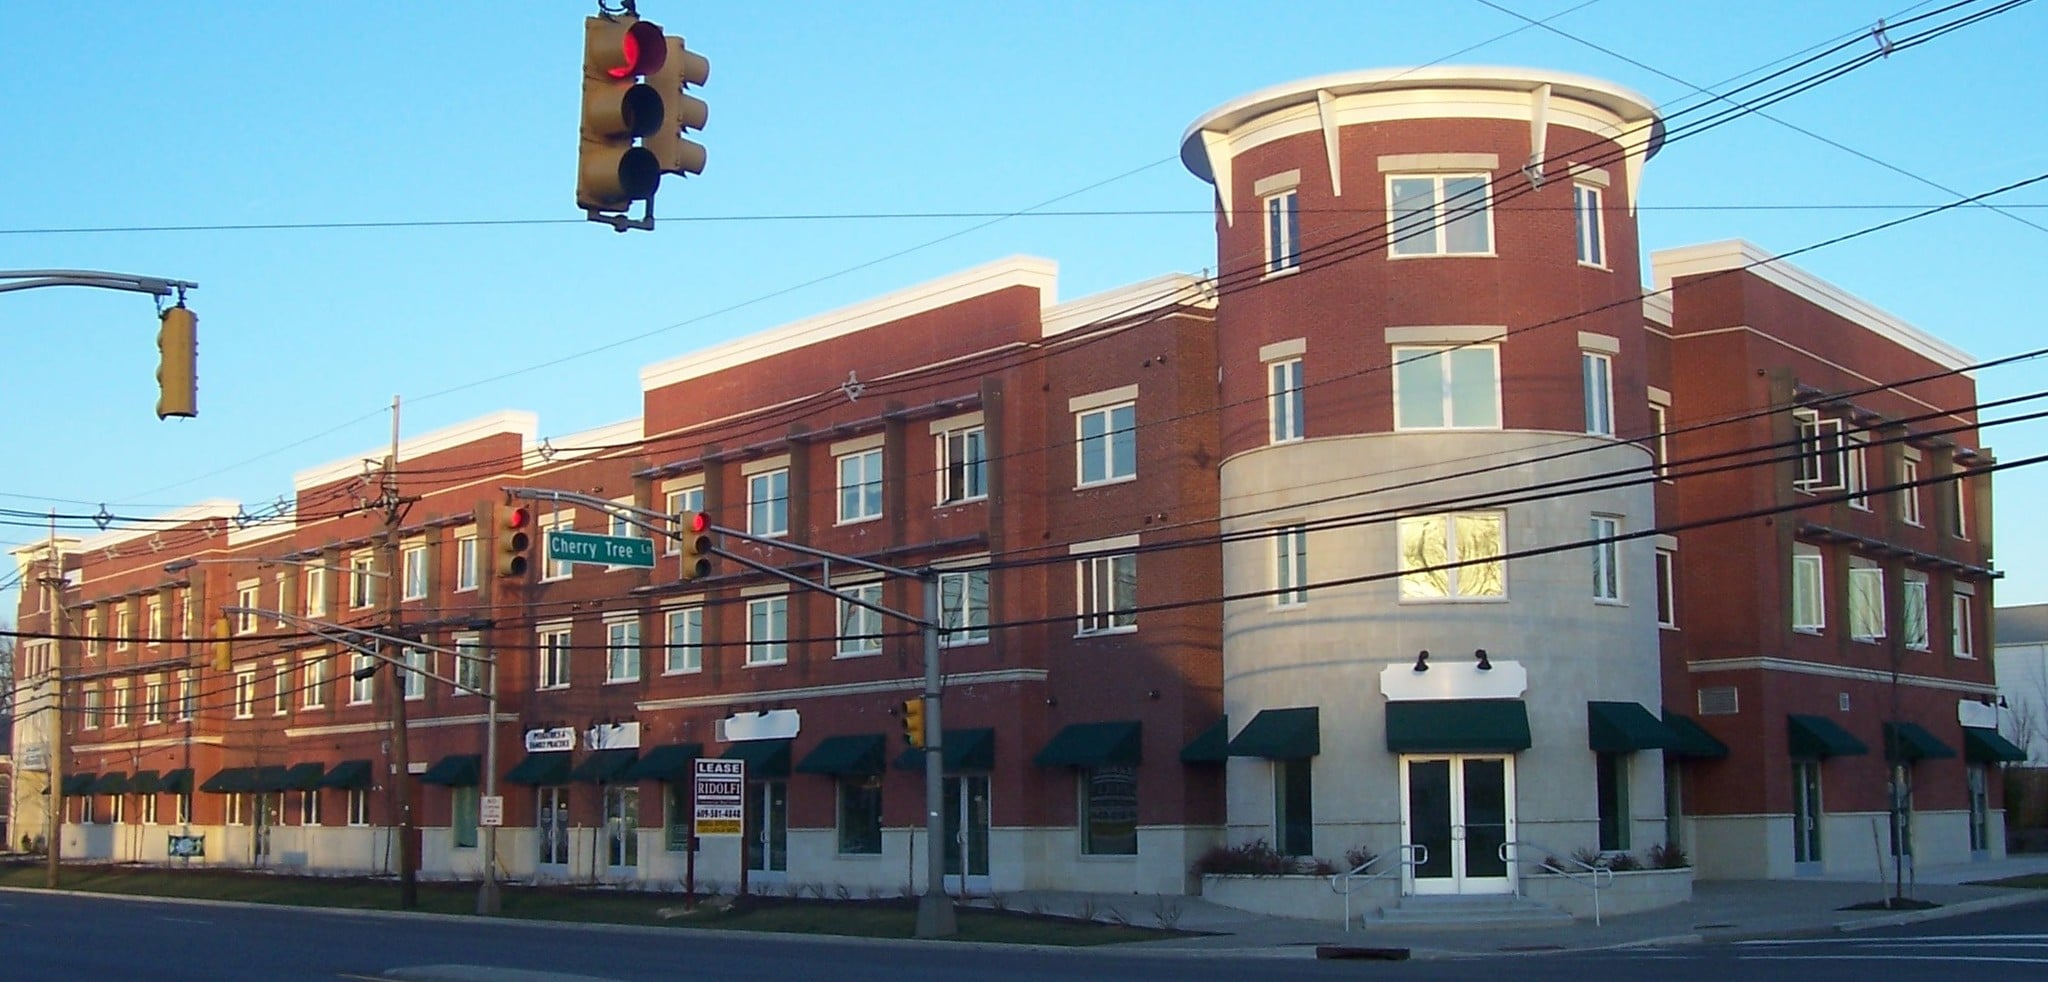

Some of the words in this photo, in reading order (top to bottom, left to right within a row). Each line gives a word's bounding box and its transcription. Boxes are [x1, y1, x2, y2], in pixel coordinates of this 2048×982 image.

[552, 537, 597, 559] Cherry
[605, 541, 633, 558] Tree
[641, 543, 652, 554] Ln
[699, 763, 740, 773] LEASE
[697, 782, 740, 795] RIDOLFI
